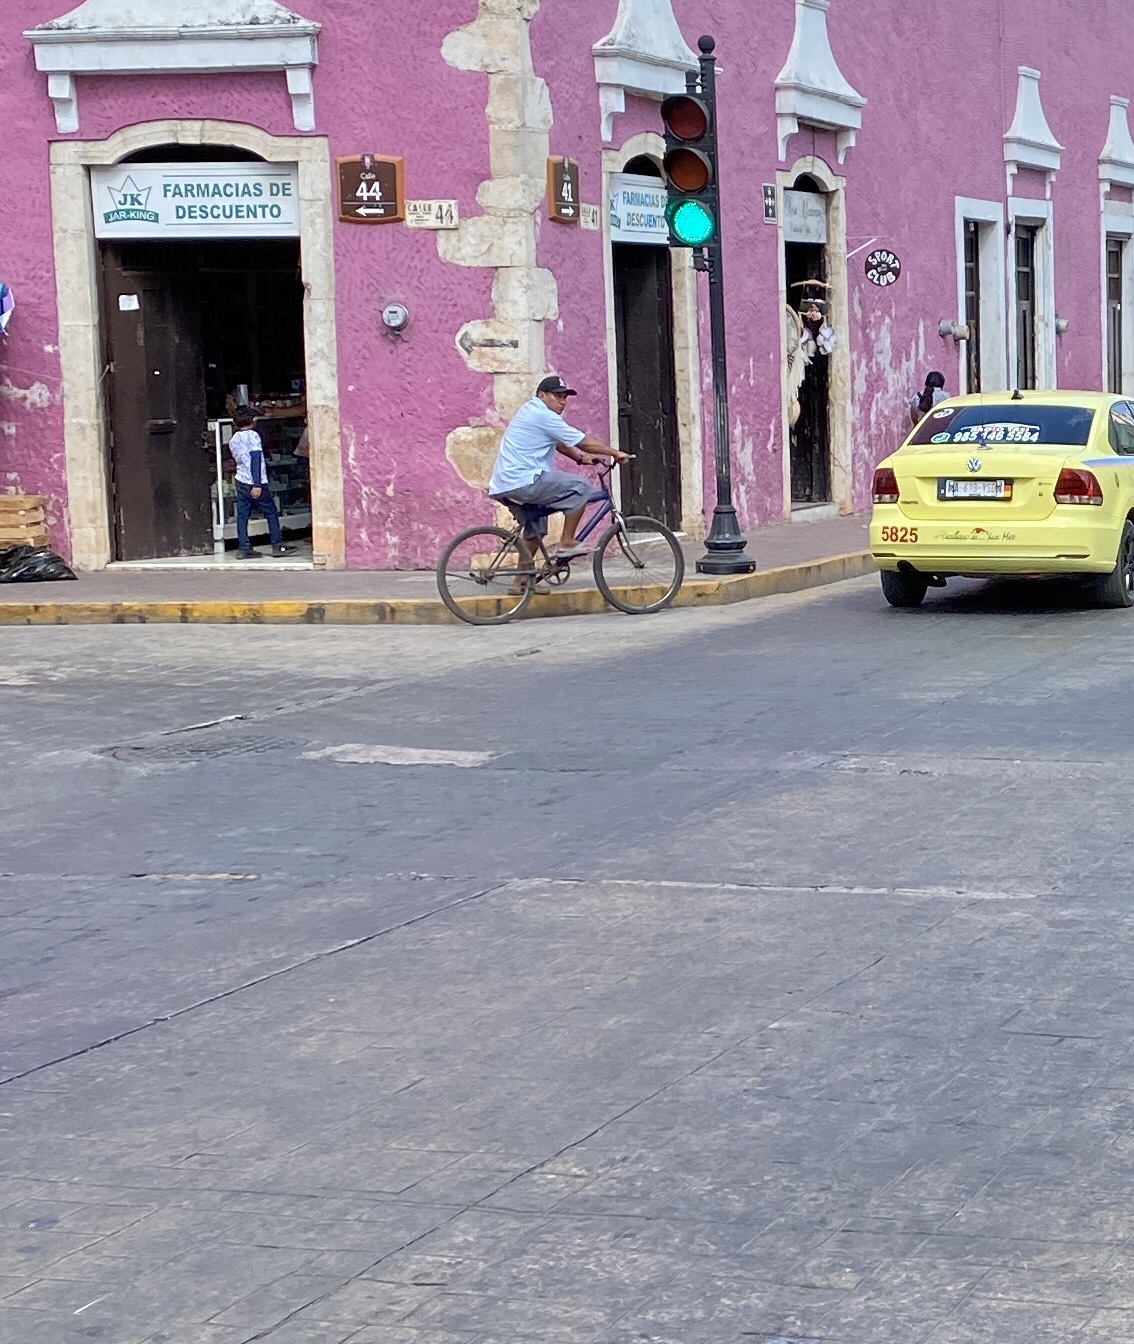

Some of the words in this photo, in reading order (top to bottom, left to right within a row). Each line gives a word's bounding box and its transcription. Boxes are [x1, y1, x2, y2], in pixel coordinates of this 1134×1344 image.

[360, 172, 376, 180] Calle
[162, 182, 263, 198] FARMACIAS
[269, 182, 292, 197] DE
[355, 181, 383, 201] 44
[562, 182, 573, 202] 41
[118, 193, 143, 206] JK
[622, 191, 660, 208] FARMACIAS
[106, 210, 155, 222] JAR-KING
[175, 204, 282, 219] DESCUENTO
[435, 203, 454, 224] 44
[626, 212, 665, 229] DESCUENTO
[868, 251, 900, 269] SPORT
[867, 269, 896, 286] CLUB
[952, 431, 977, 442] 985
[1005, 431, 1040, 442] 5584
[881, 526, 919, 543] 5825
